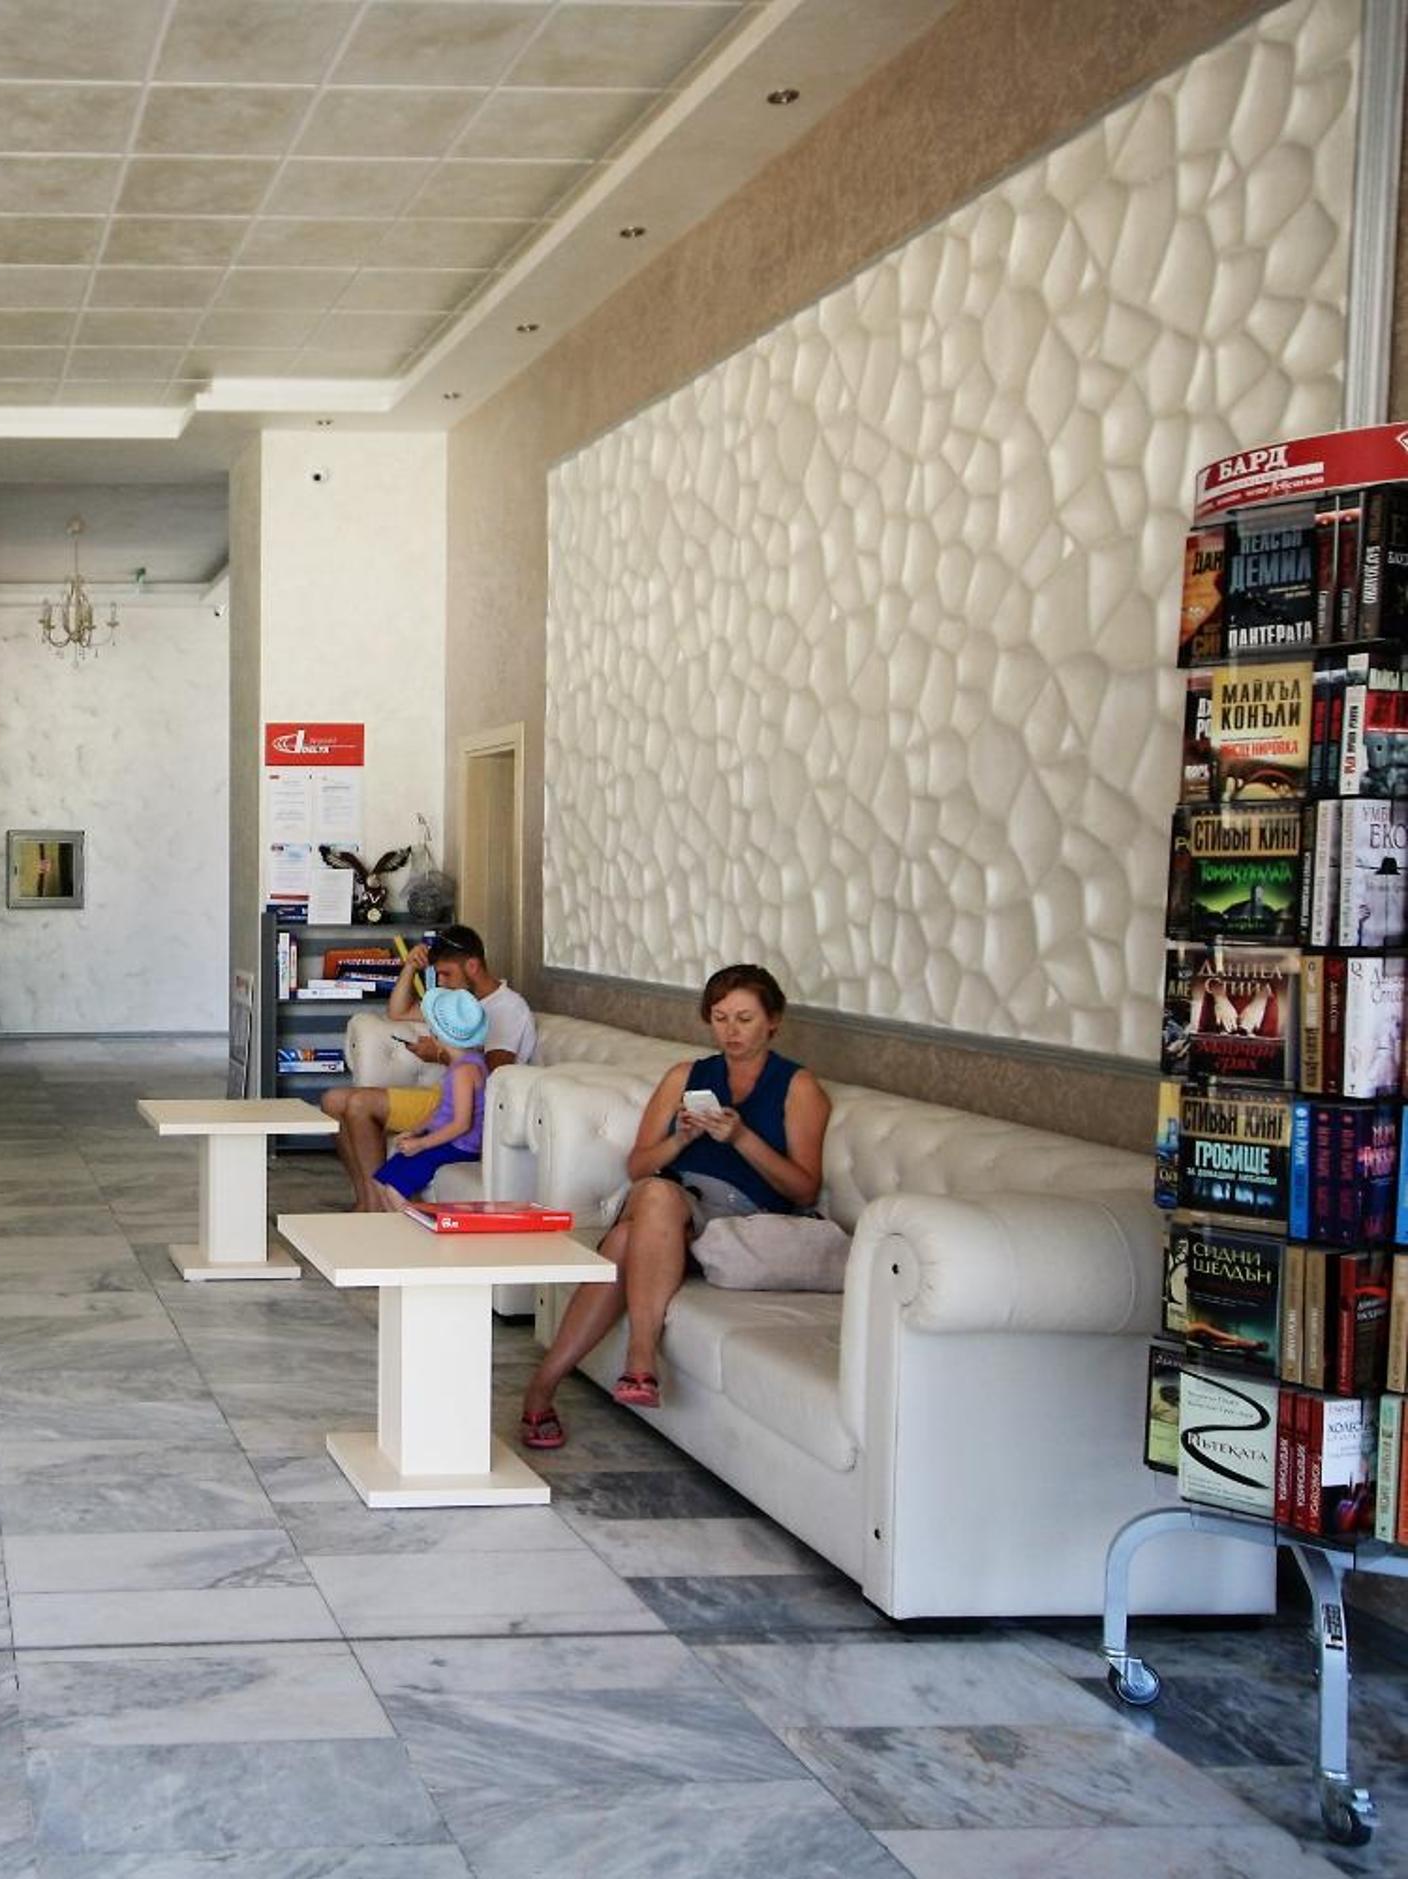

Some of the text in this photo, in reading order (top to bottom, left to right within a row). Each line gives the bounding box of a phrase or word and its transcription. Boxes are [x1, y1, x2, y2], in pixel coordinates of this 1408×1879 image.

[1218, 445, 1289, 481] БАРД
[1229, 548, 1312, 594] ДЕМИЛ
[1228, 621, 1313, 649] ПАНТЕРАТА
[1222, 677, 1302, 704] МАЙКЪЛ
[1221, 702, 1302, 731] КОНЪЛИ
[1194, 819, 1251, 851] СТИВЪН
[1182, 1100, 1238, 1136] СТИВЪН
[1194, 1140, 1271, 1175] ГРОБИЩЕ
[1193, 1241, 1261, 1267] СИДНИ
[1193, 1258, 1272, 1285] ШЕЛДЪН
